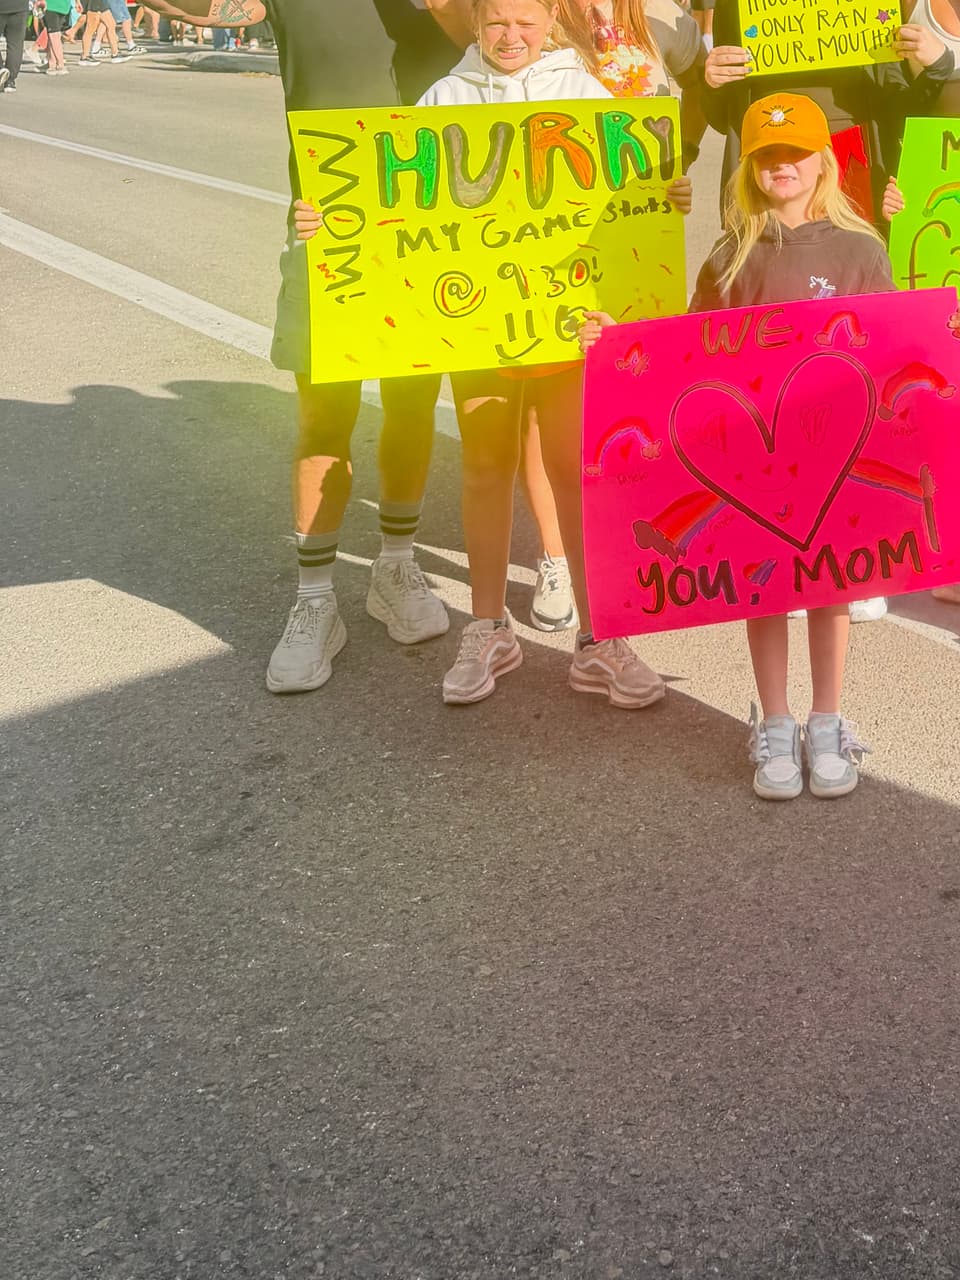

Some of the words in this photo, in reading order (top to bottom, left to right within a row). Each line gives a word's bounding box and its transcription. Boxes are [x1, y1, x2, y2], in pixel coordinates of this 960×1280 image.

[761, 13, 805, 37] ONLY
[817, 7, 867, 31] RAN
[747, 40, 807, 72] YOUR
[375, 111, 675, 210] HURRY
[396, 222, 461, 258] MY
[481, 207, 593, 248] GAME
[433, 270, 487, 318] @
[702, 308, 793, 357] WE
[793, 531, 923, 592] MOM
